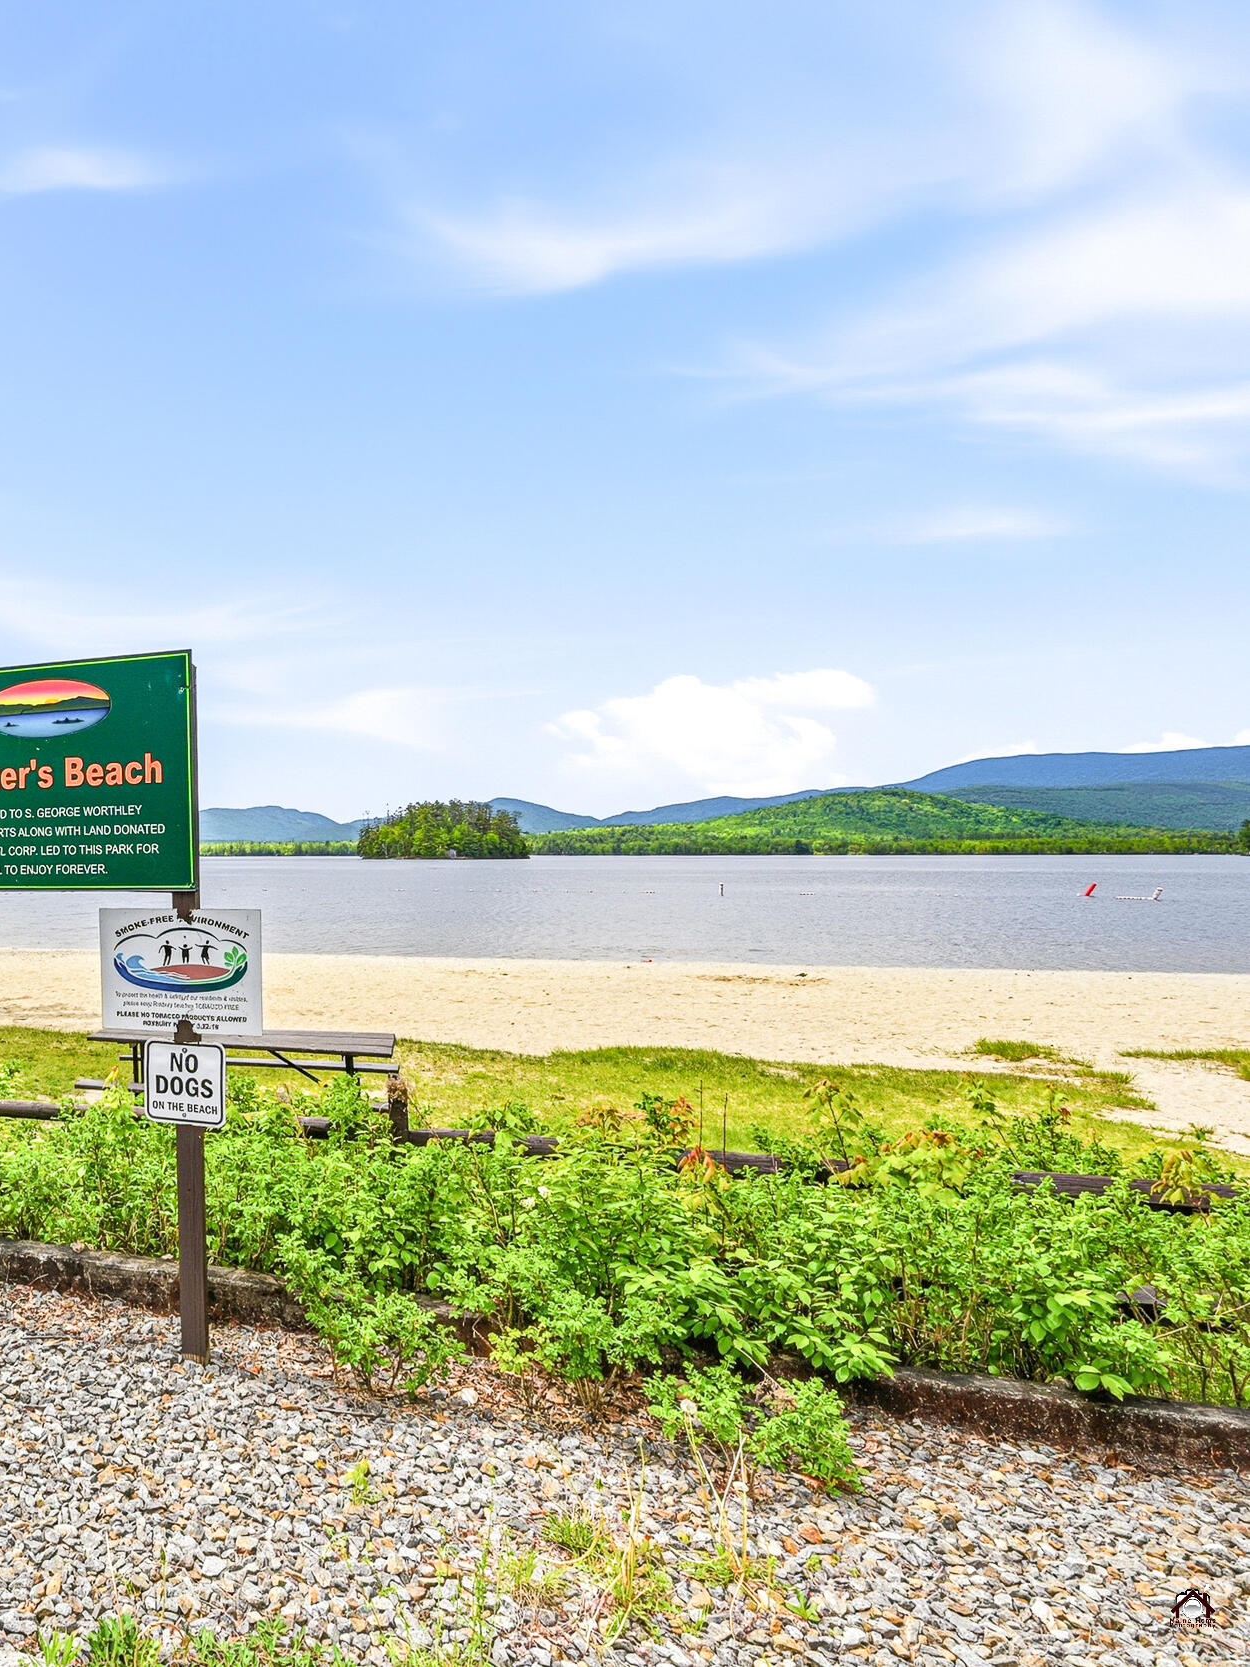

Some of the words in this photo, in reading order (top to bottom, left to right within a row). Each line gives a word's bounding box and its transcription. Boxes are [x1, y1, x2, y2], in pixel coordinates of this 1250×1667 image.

[64, 752, 163, 788] Beach
[9, 808, 23, 819] TO
[24, 808, 34, 818] S.
[36, 806, 80, 818] GEORGE
[83, 804, 142, 816] WORTHLEY
[18, 826, 52, 837] ALONG
[55, 826, 81, 836] WITH
[84, 825, 111, 835] LAND
[114, 824, 165, 835] DONATED
[8, 846, 38, 856] CORP.
[41, 845, 60, 856] LED
[62, 845, 76, 855] TO
[79, 844, 102, 855] THIS
[105, 844, 134, 855] PARK
[136, 843, 159, 854] FOR
[4, 865, 18, 875] TO
[20, 865, 53, 875] ENJOY
[56, 864, 108, 874] FOREVER.
[115, 915, 174, 937] SMOKE-FREE
[178, 912, 249, 939] VIRONMENT
[216, 1015, 247, 1023] ALLOWED
[170, 1052, 198, 1074] NO
[156, 1074, 214, 1098] DOGS
[152, 1100, 164, 1109] ON
[167, 1101, 184, 1111] THE
[187, 1104, 218, 1115] BEACH
